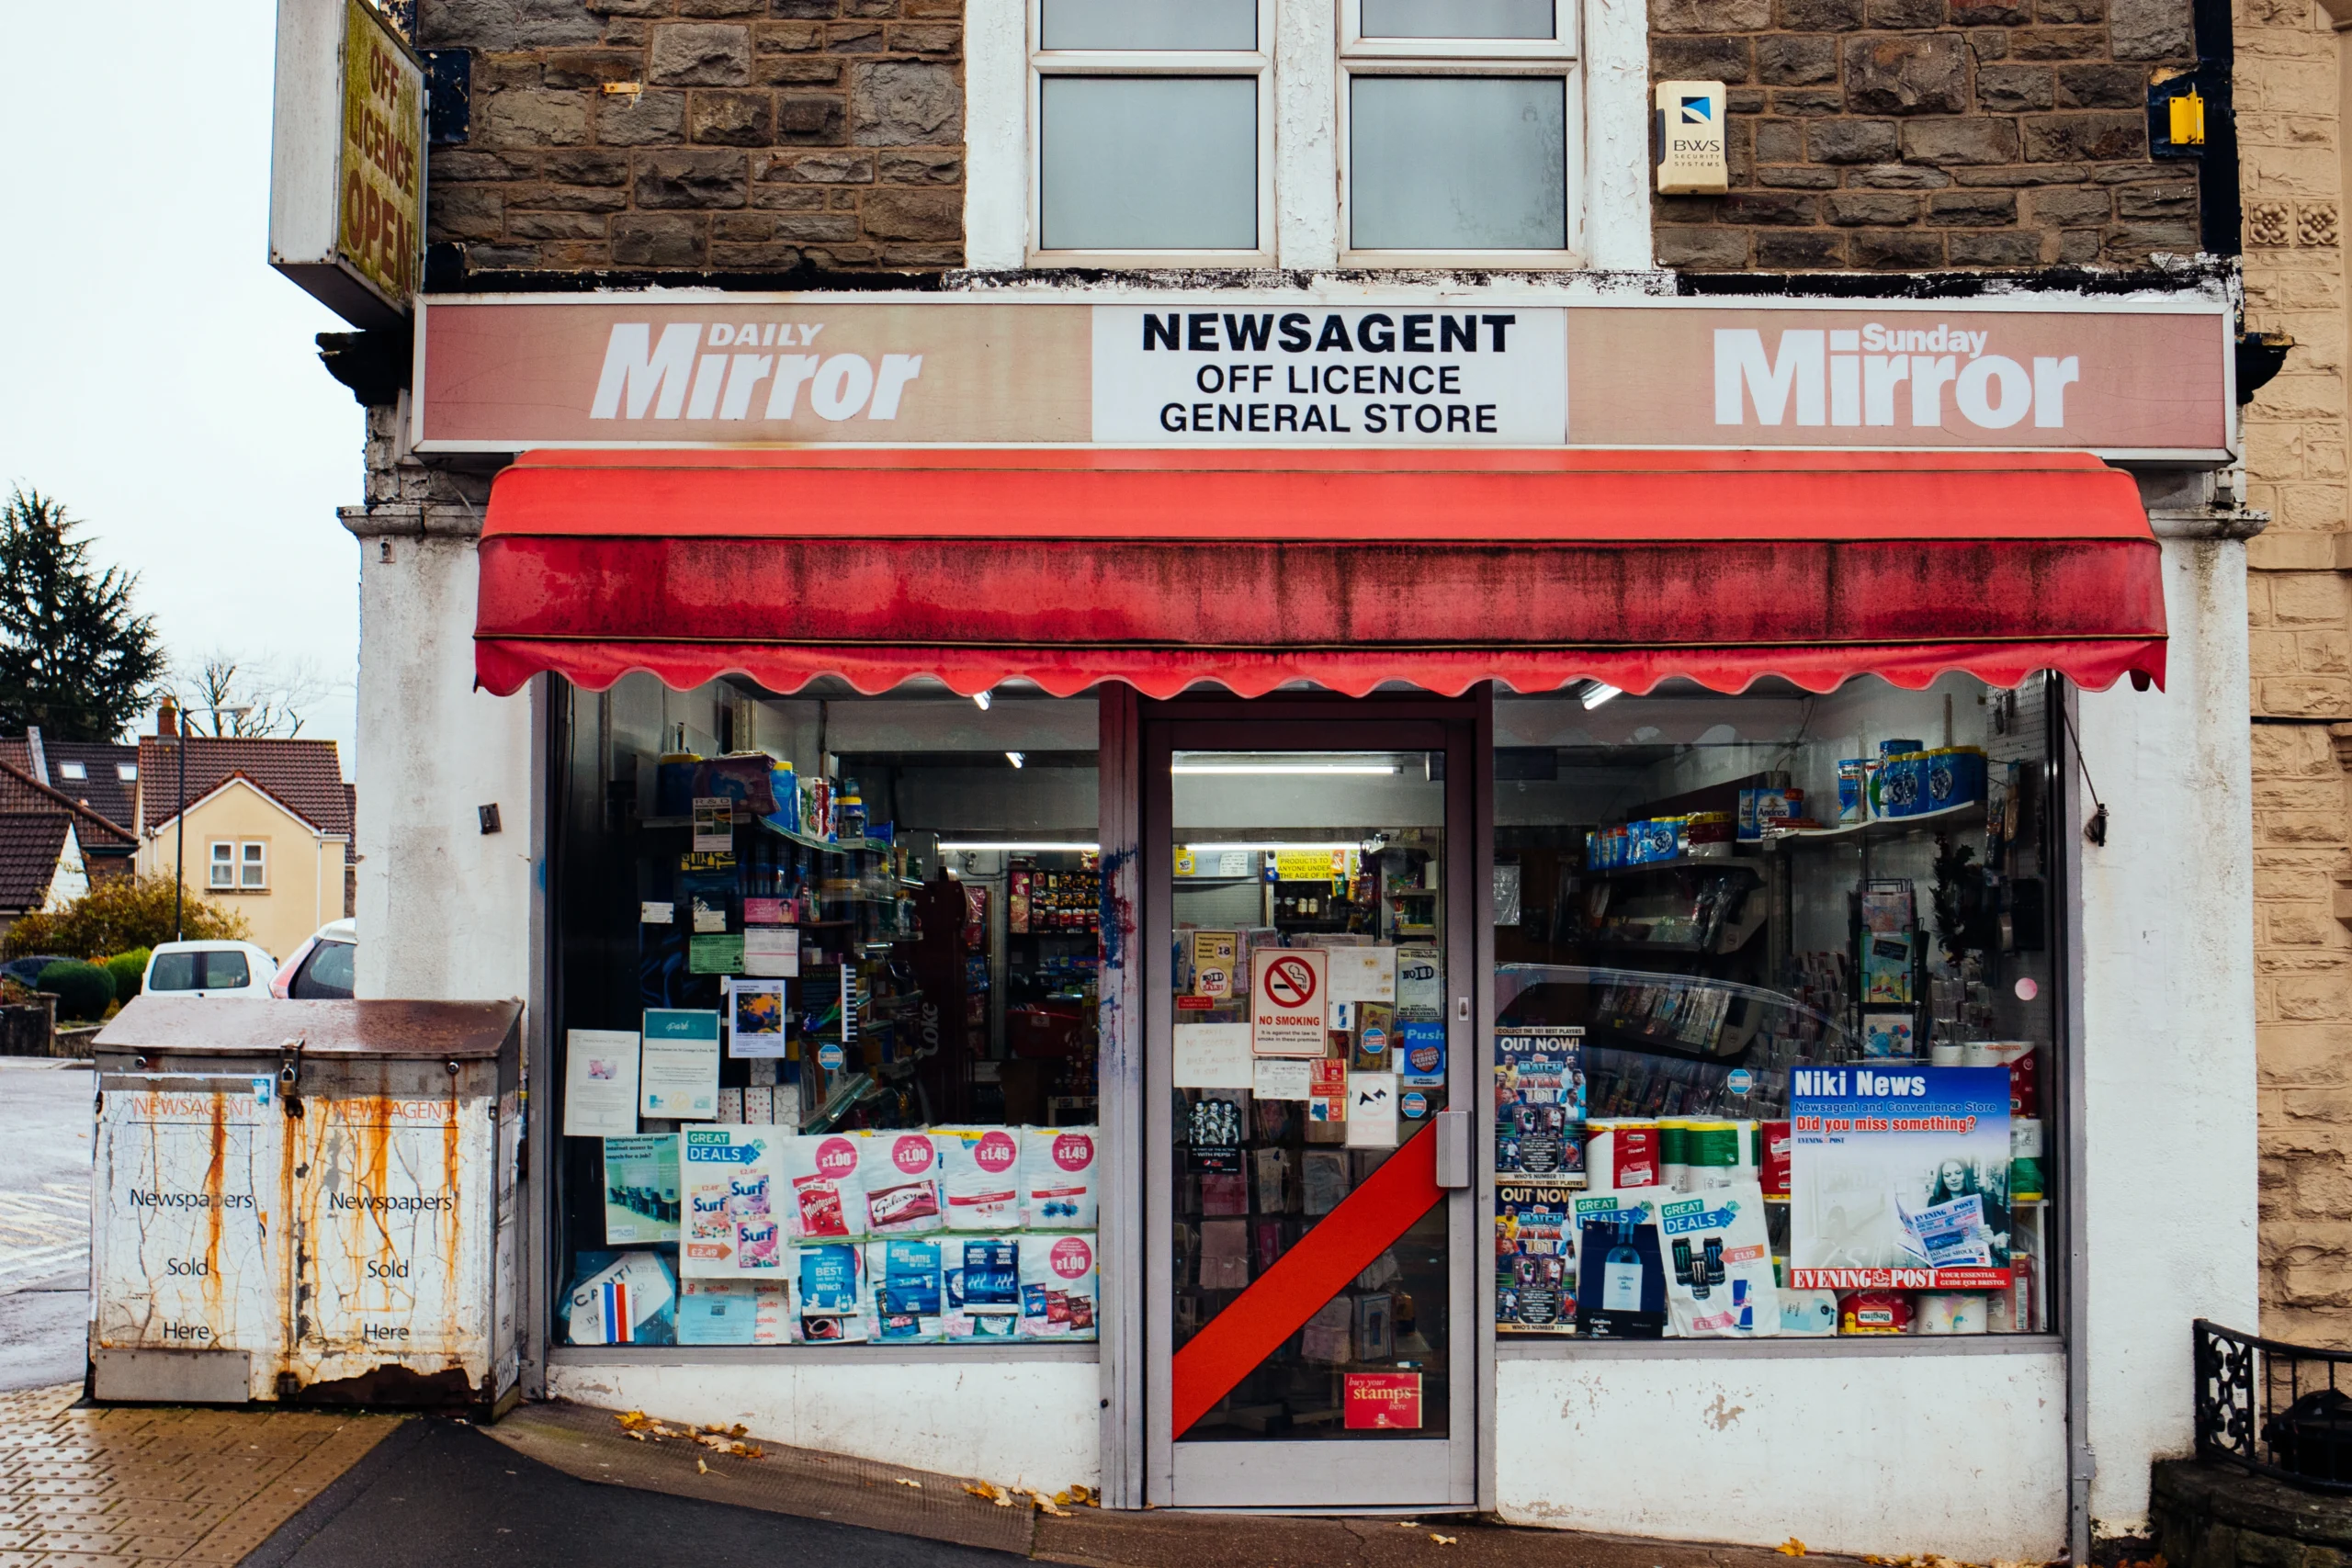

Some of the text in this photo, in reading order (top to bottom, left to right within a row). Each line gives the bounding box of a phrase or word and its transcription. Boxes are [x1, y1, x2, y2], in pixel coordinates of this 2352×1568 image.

[370, 43, 400, 110] OFF
[348, 98, 414, 199] LICENCE
[1674, 140, 1720, 152] BWS
[346, 168, 413, 294] OPEN
[707, 322, 825, 346] DAILY
[1143, 312, 1516, 353] NEWSAGENT
[1862, 322, 1988, 358] Sunday
[590, 322, 923, 421] Mirror
[1714, 328, 2079, 429] Mirror
[1196, 364, 1461, 395] OFF LICENCE
[1160, 403, 1498, 434] GENERAL STORE
[1758, 808, 1788, 817] Andrex
[1217, 947, 1230, 955] 18
[1211, 973, 1224, 981] ID
[1414, 966, 1434, 980] ID
[1260, 1016, 1319, 1026] NO SMOKING
[1407, 1029, 1444, 1040] Push
[1500, 1037, 1579, 1051] OUT NOW!
[1412, 1055, 1439, 1064] PERFECT
[1519, 1062, 1563, 1073] MATCH
[1517, 1077, 1563, 1089] ATTAX
[1794, 1071, 1926, 1097] Niki News
[1526, 1089, 1554, 1102] 101
[132, 1097, 254, 1118] NEWSAGENT
[331, 1100, 452, 1119] NEWSAGENT
[1794, 1102, 1996, 1114] Newsagent and Convenience Store
[1796, 1117, 1975, 1134] Did you miss something?
[690, 1134, 728, 1143] GREAT
[690, 1149, 741, 1160] DEALS
[899, 1148, 927, 1162] £1.00
[981, 1147, 1010, 1160] £1.49
[1058, 1146, 1087, 1159] £1.49
[822, 1153, 851, 1167] £1.00
[731, 1180, 765, 1196] Surf
[1501, 1188, 1532, 1202] OUT
[130, 1189, 253, 1213] Newspapers
[330, 1192, 453, 1214] Newspapers
[694, 1197, 727, 1212] Surf
[803, 1196, 837, 1220] Maltesers
[875, 1194, 917, 1214] Galaxy
[1577, 1200, 1615, 1211] GREAT
[1664, 1201, 1701, 1215] GREAT
[1915, 1201, 1973, 1222] EVENING POST
[1518, 1213, 1562, 1225] MATCH
[1667, 1213, 1717, 1233] DEALS
[741, 1227, 774, 1242] Surf
[1517, 1227, 1563, 1240] ATTAX
[691, 1248, 718, 1257] £2.49
[1525, 1241, 1554, 1254] 101
[1735, 1250, 1756, 1260] £1.19
[167, 1258, 209, 1277] Sold
[368, 1259, 409, 1279] Sold
[1057, 1257, 1085, 1269] £1.00
[816, 1267, 842, 1276] BEST
[1793, 1269, 1939, 1288] EVENING POST
[816, 1282, 845, 1291] Which?
[1860, 1313, 1890, 1321] Regina
[163, 1322, 209, 1340] Here
[1700, 1320, 1721, 1329] £1.59
[363, 1324, 410, 1341] Here
[1349, 1377, 1385, 1388] buy your
[1353, 1387, 1411, 1404] stamps
[1389, 1401, 1407, 1410] here
